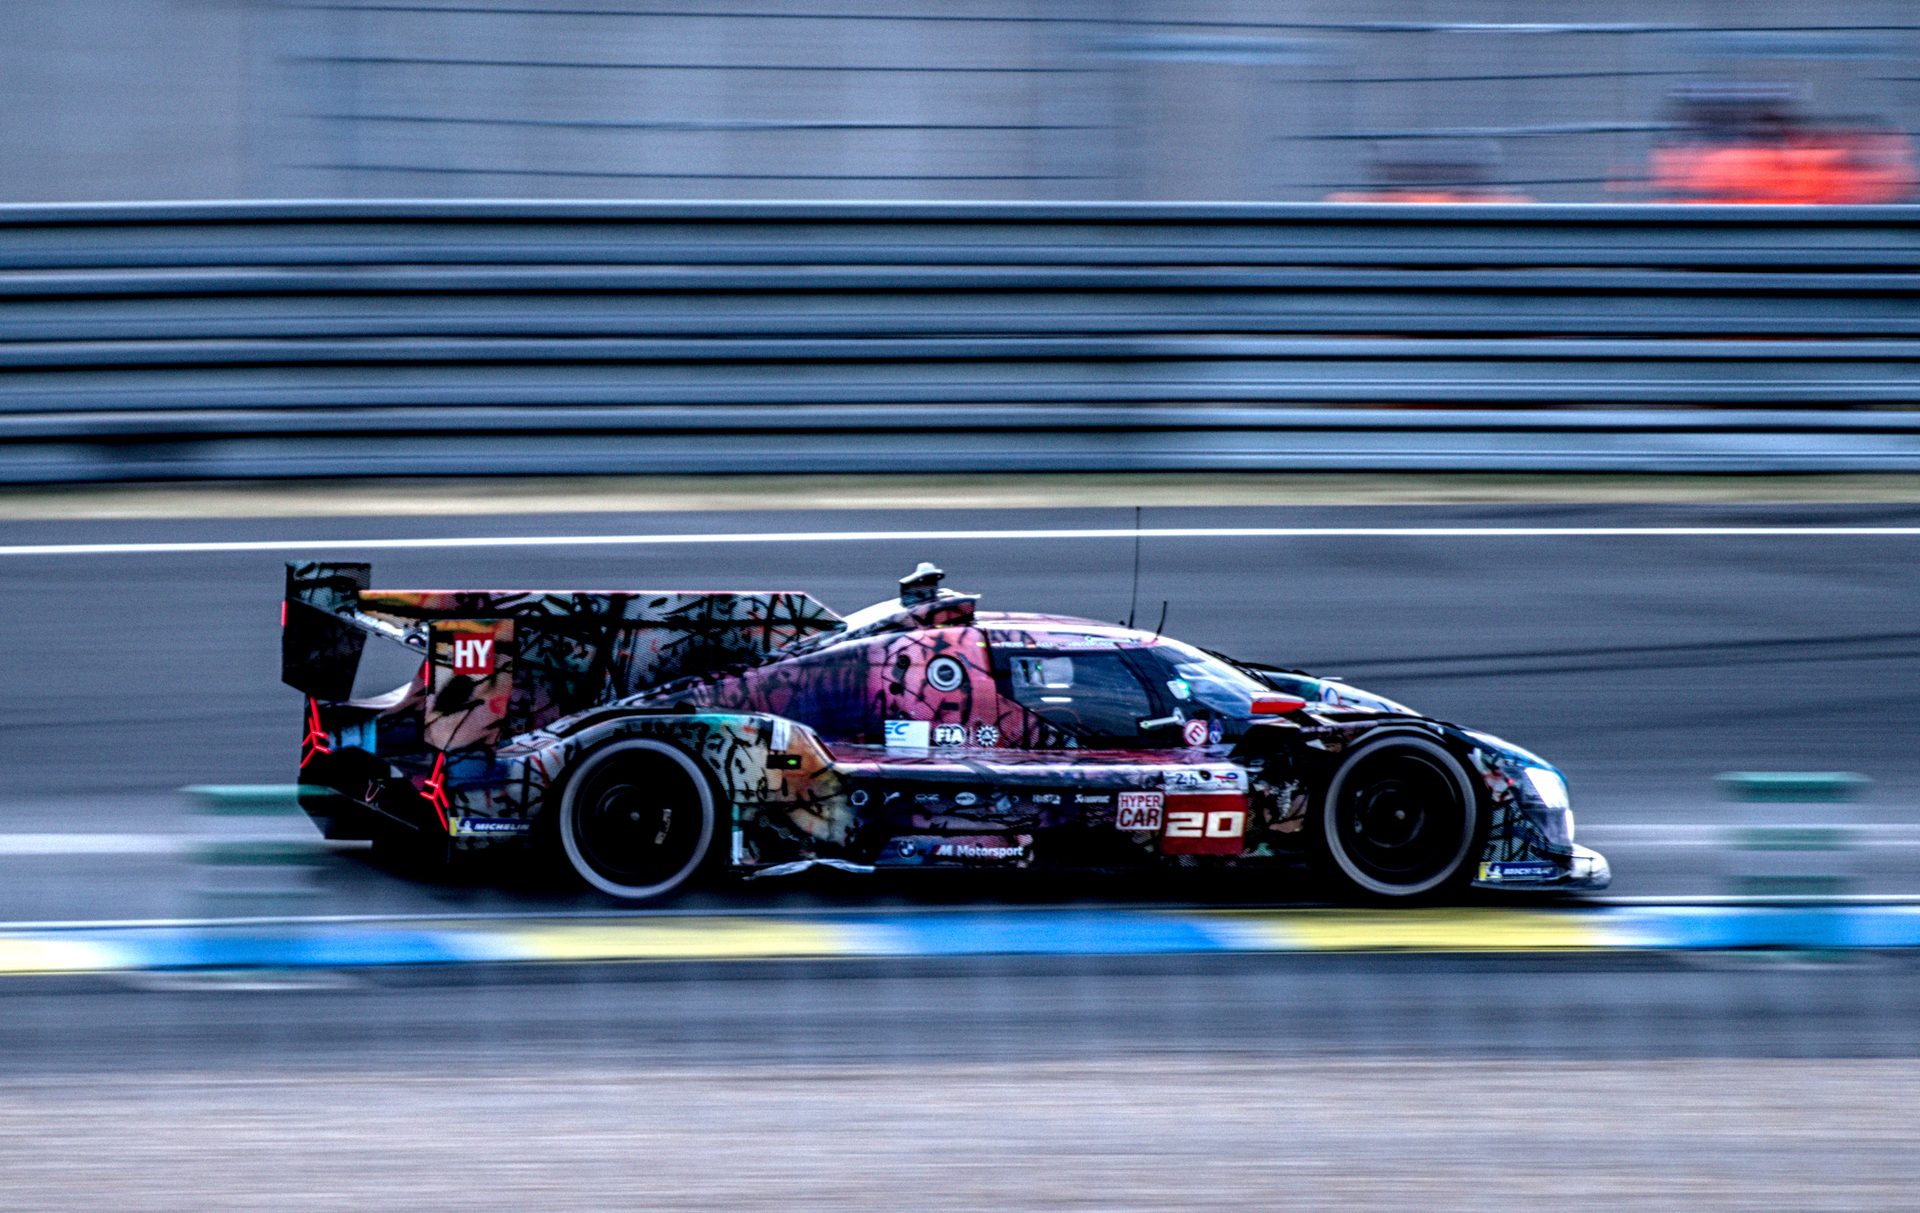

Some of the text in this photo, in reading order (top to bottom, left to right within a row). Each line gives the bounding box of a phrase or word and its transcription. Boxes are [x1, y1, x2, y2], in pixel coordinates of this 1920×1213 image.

[455, 639, 492, 668] HY
[936, 727, 963, 743] FIA
[1120, 795, 1160, 808] HYPER
[1119, 808, 1159, 827] CAR
[1164, 811, 1245, 838] 20
[474, 822, 530, 831] MICHELIN
[956, 844, 1023, 859] Motorsport
